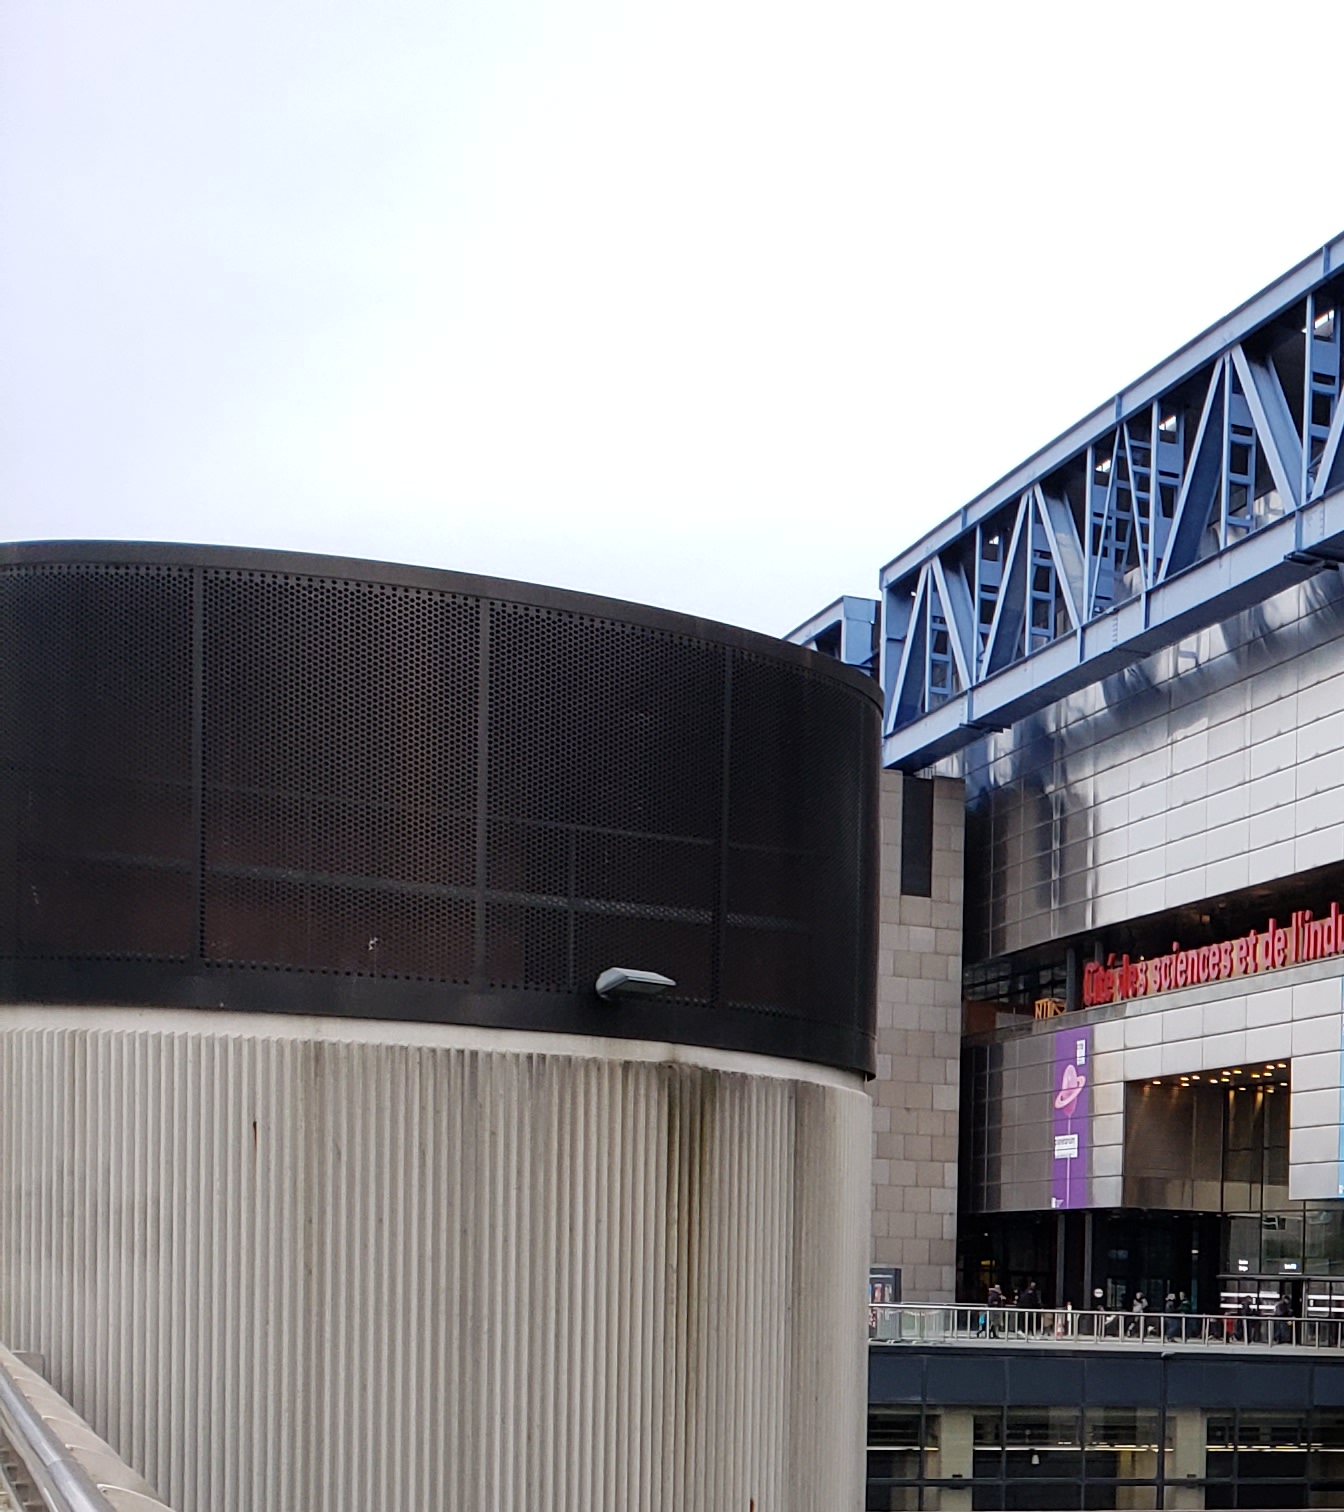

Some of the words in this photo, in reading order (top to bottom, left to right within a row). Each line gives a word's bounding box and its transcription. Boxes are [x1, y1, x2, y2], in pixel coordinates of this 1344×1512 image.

[1152, 941, 1233, 992] sciences
[1237, 929, 1259, 974] et
[1262, 918, 1288, 970] de
